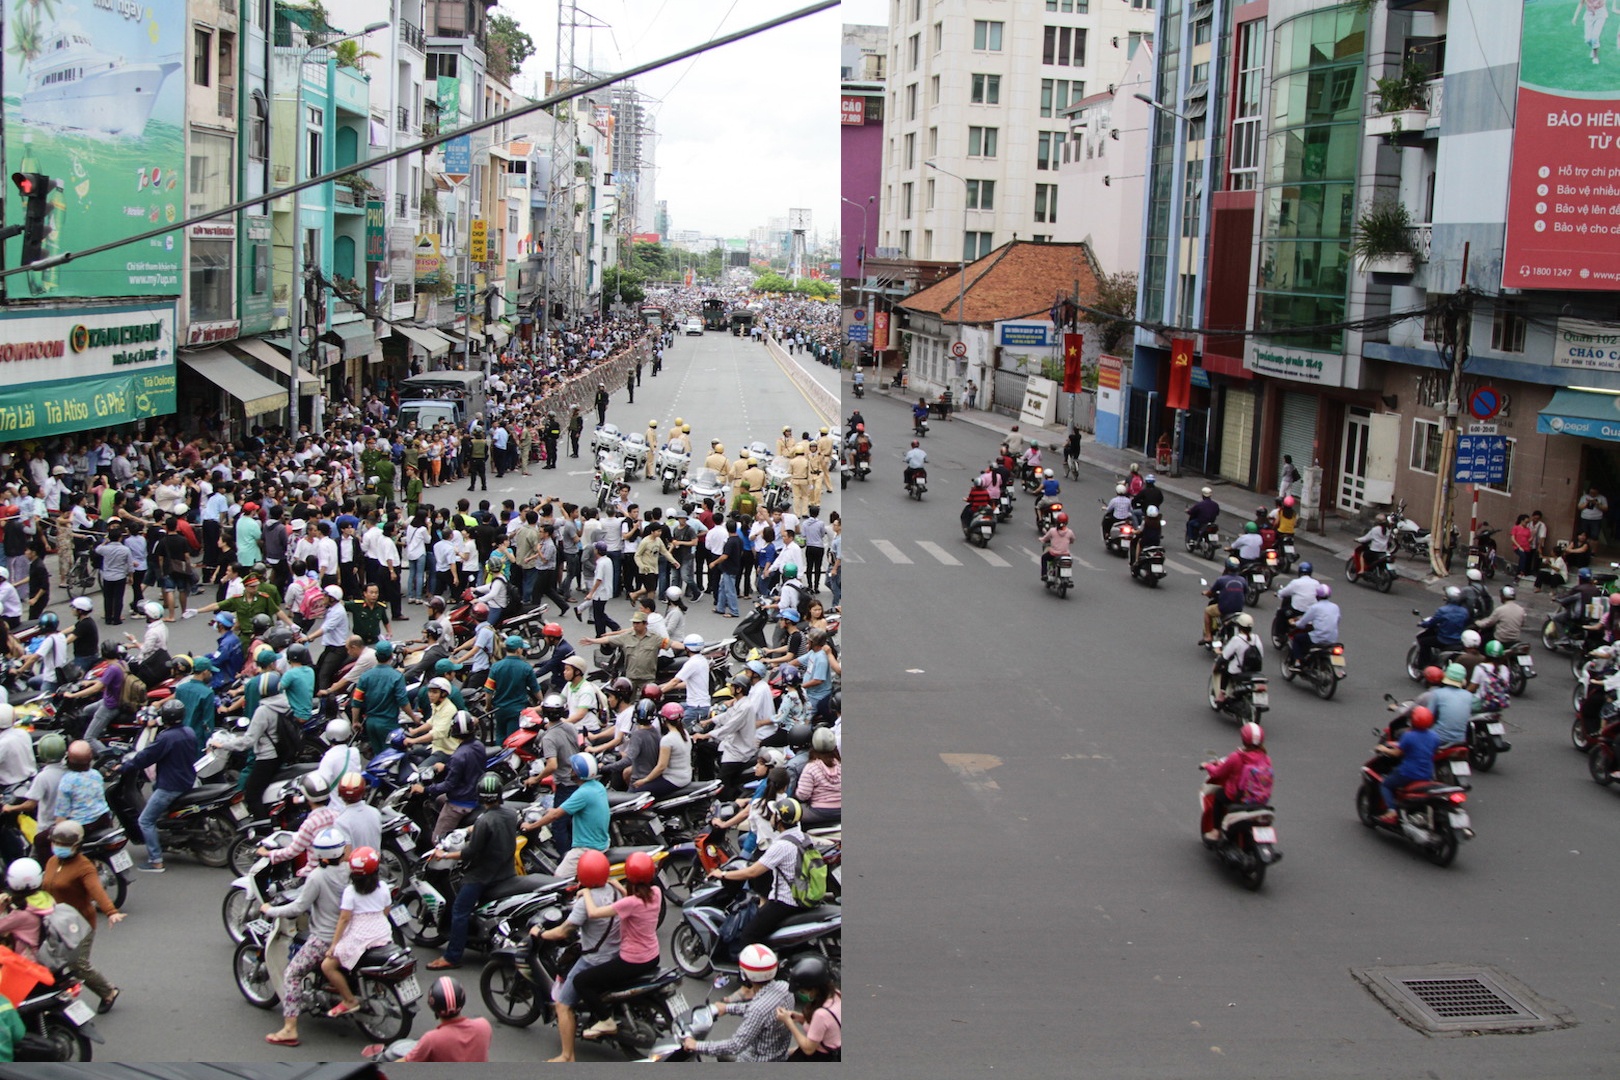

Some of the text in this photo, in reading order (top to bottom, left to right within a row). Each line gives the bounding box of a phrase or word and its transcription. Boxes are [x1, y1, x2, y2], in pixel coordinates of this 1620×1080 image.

[842, 99, 862, 112] CÁO
[1547, 110, 1582, 127] BẢO
[1588, 132, 1612, 149] TỪ
[1558, 165, 1572, 176] Hỗ
[1575, 166, 1589, 178] trợ
[1592, 167, 1606, 177] chi
[1557, 184, 1576, 195] Bảo
[1579, 185, 1590, 196] vệ
[1593, 184, 1620, 196] nhiều
[1555, 203, 1574, 213] Bảo
[1577, 204, 1588, 215] vệ
[1592, 205, 1606, 214] lên
[1554, 222, 1573, 232] Bảo
[1576, 223, 1587, 234] vệ
[1590, 223, 1608, 233] cho
[1533, 267, 1551, 276] 1800
[1553, 268, 1572, 277] 1247
[1596, 334, 1617, 344] 102
[1568, 346, 1620, 361] CHÁO C
[143, 374, 175, 387] Trà Oolong
[94, 394, 108, 416] Cà
[0, 403, 35, 430] Trà Lài
[45, 400, 89, 424] Trà Atiso
[1563, 422, 1589, 431] pepsi
